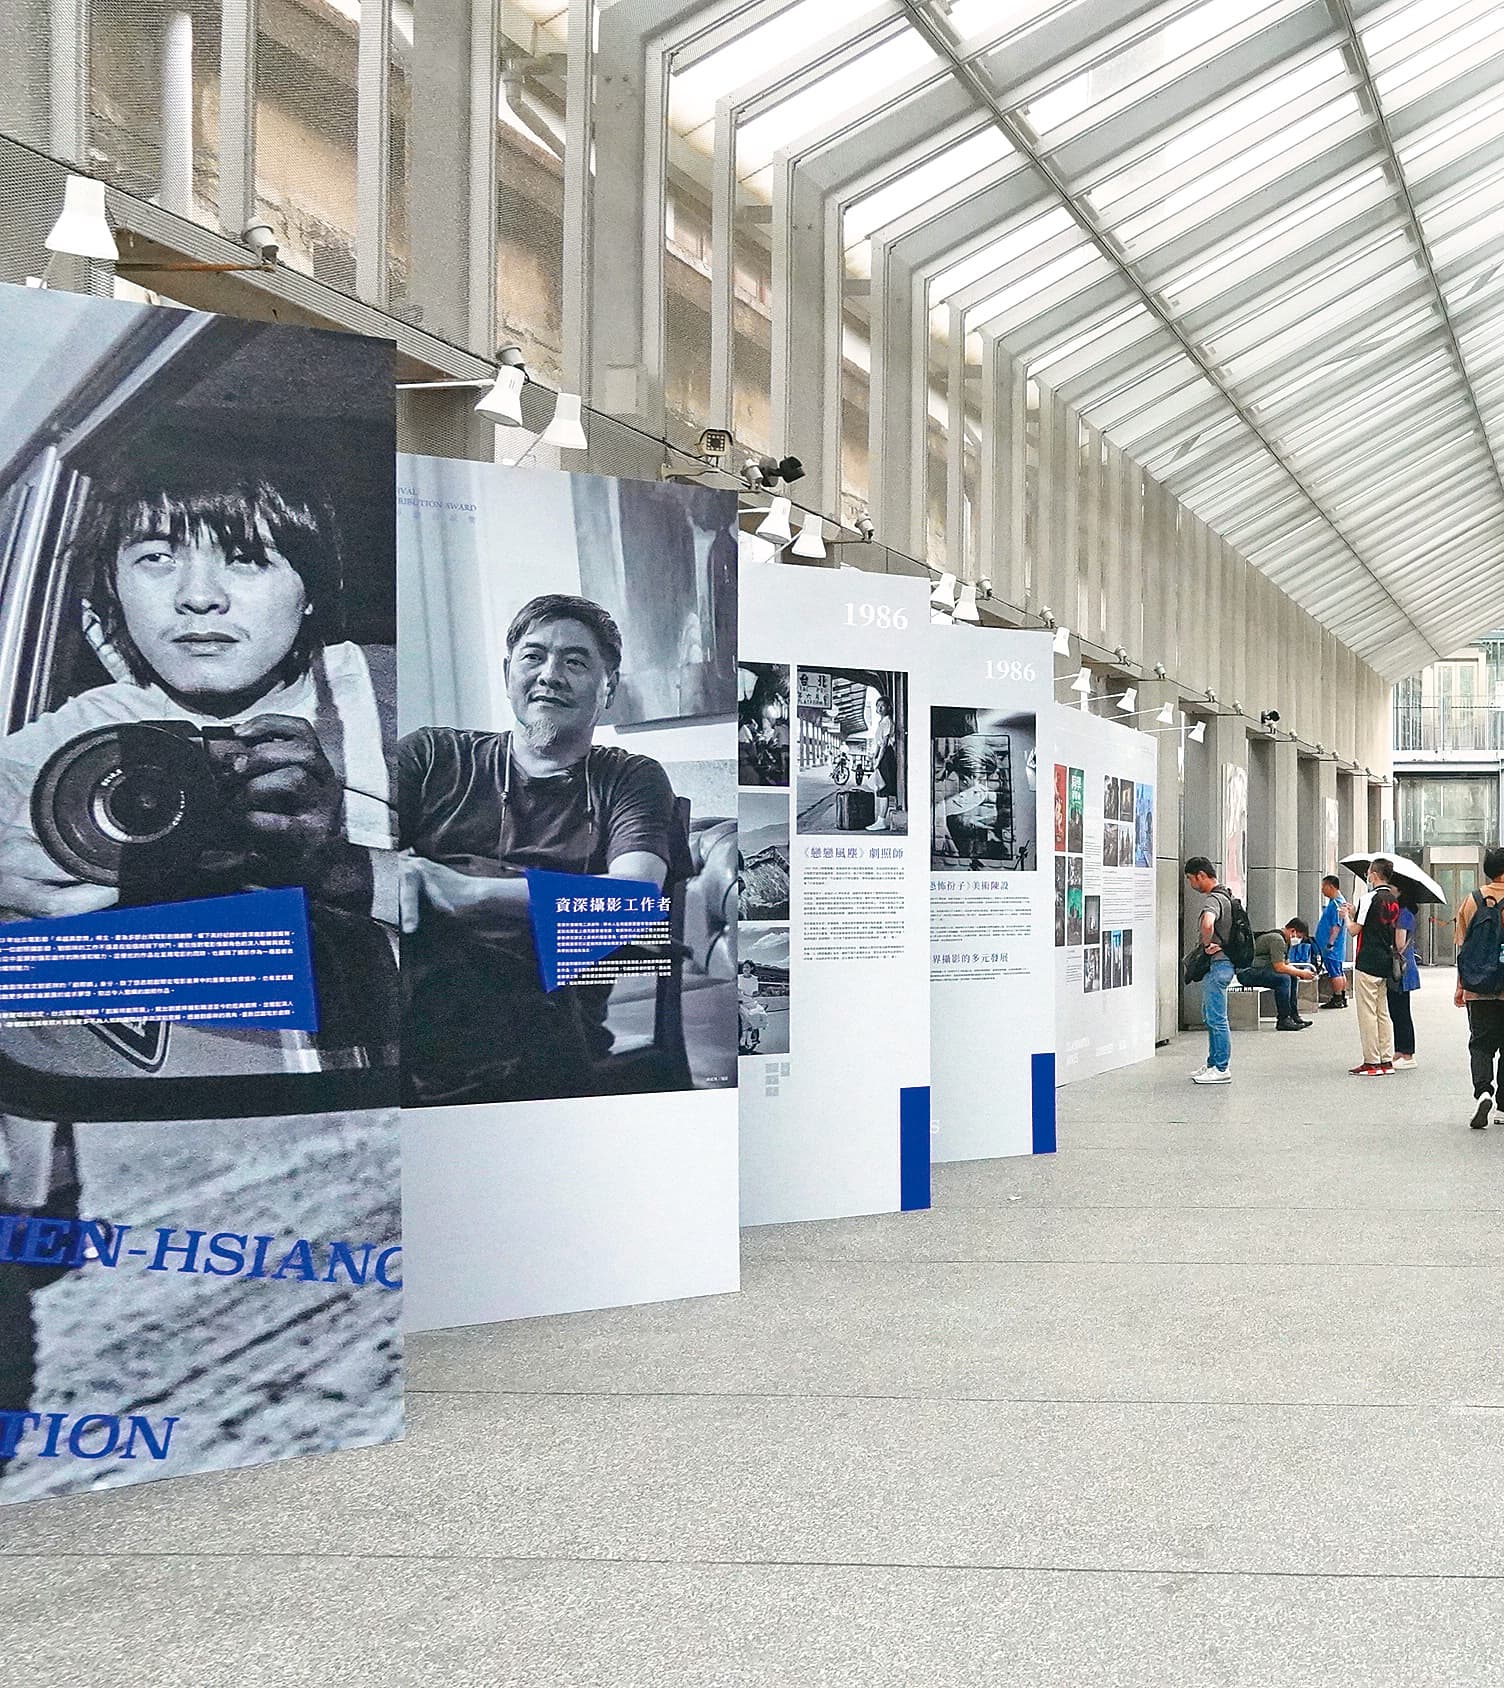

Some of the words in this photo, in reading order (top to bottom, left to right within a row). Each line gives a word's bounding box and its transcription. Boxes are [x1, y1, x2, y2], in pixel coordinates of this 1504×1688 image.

[844, 603, 909, 630] 1986
[984, 659, 1036, 681] 1986
[555, 896, 672, 913] 資深攝影工作者
